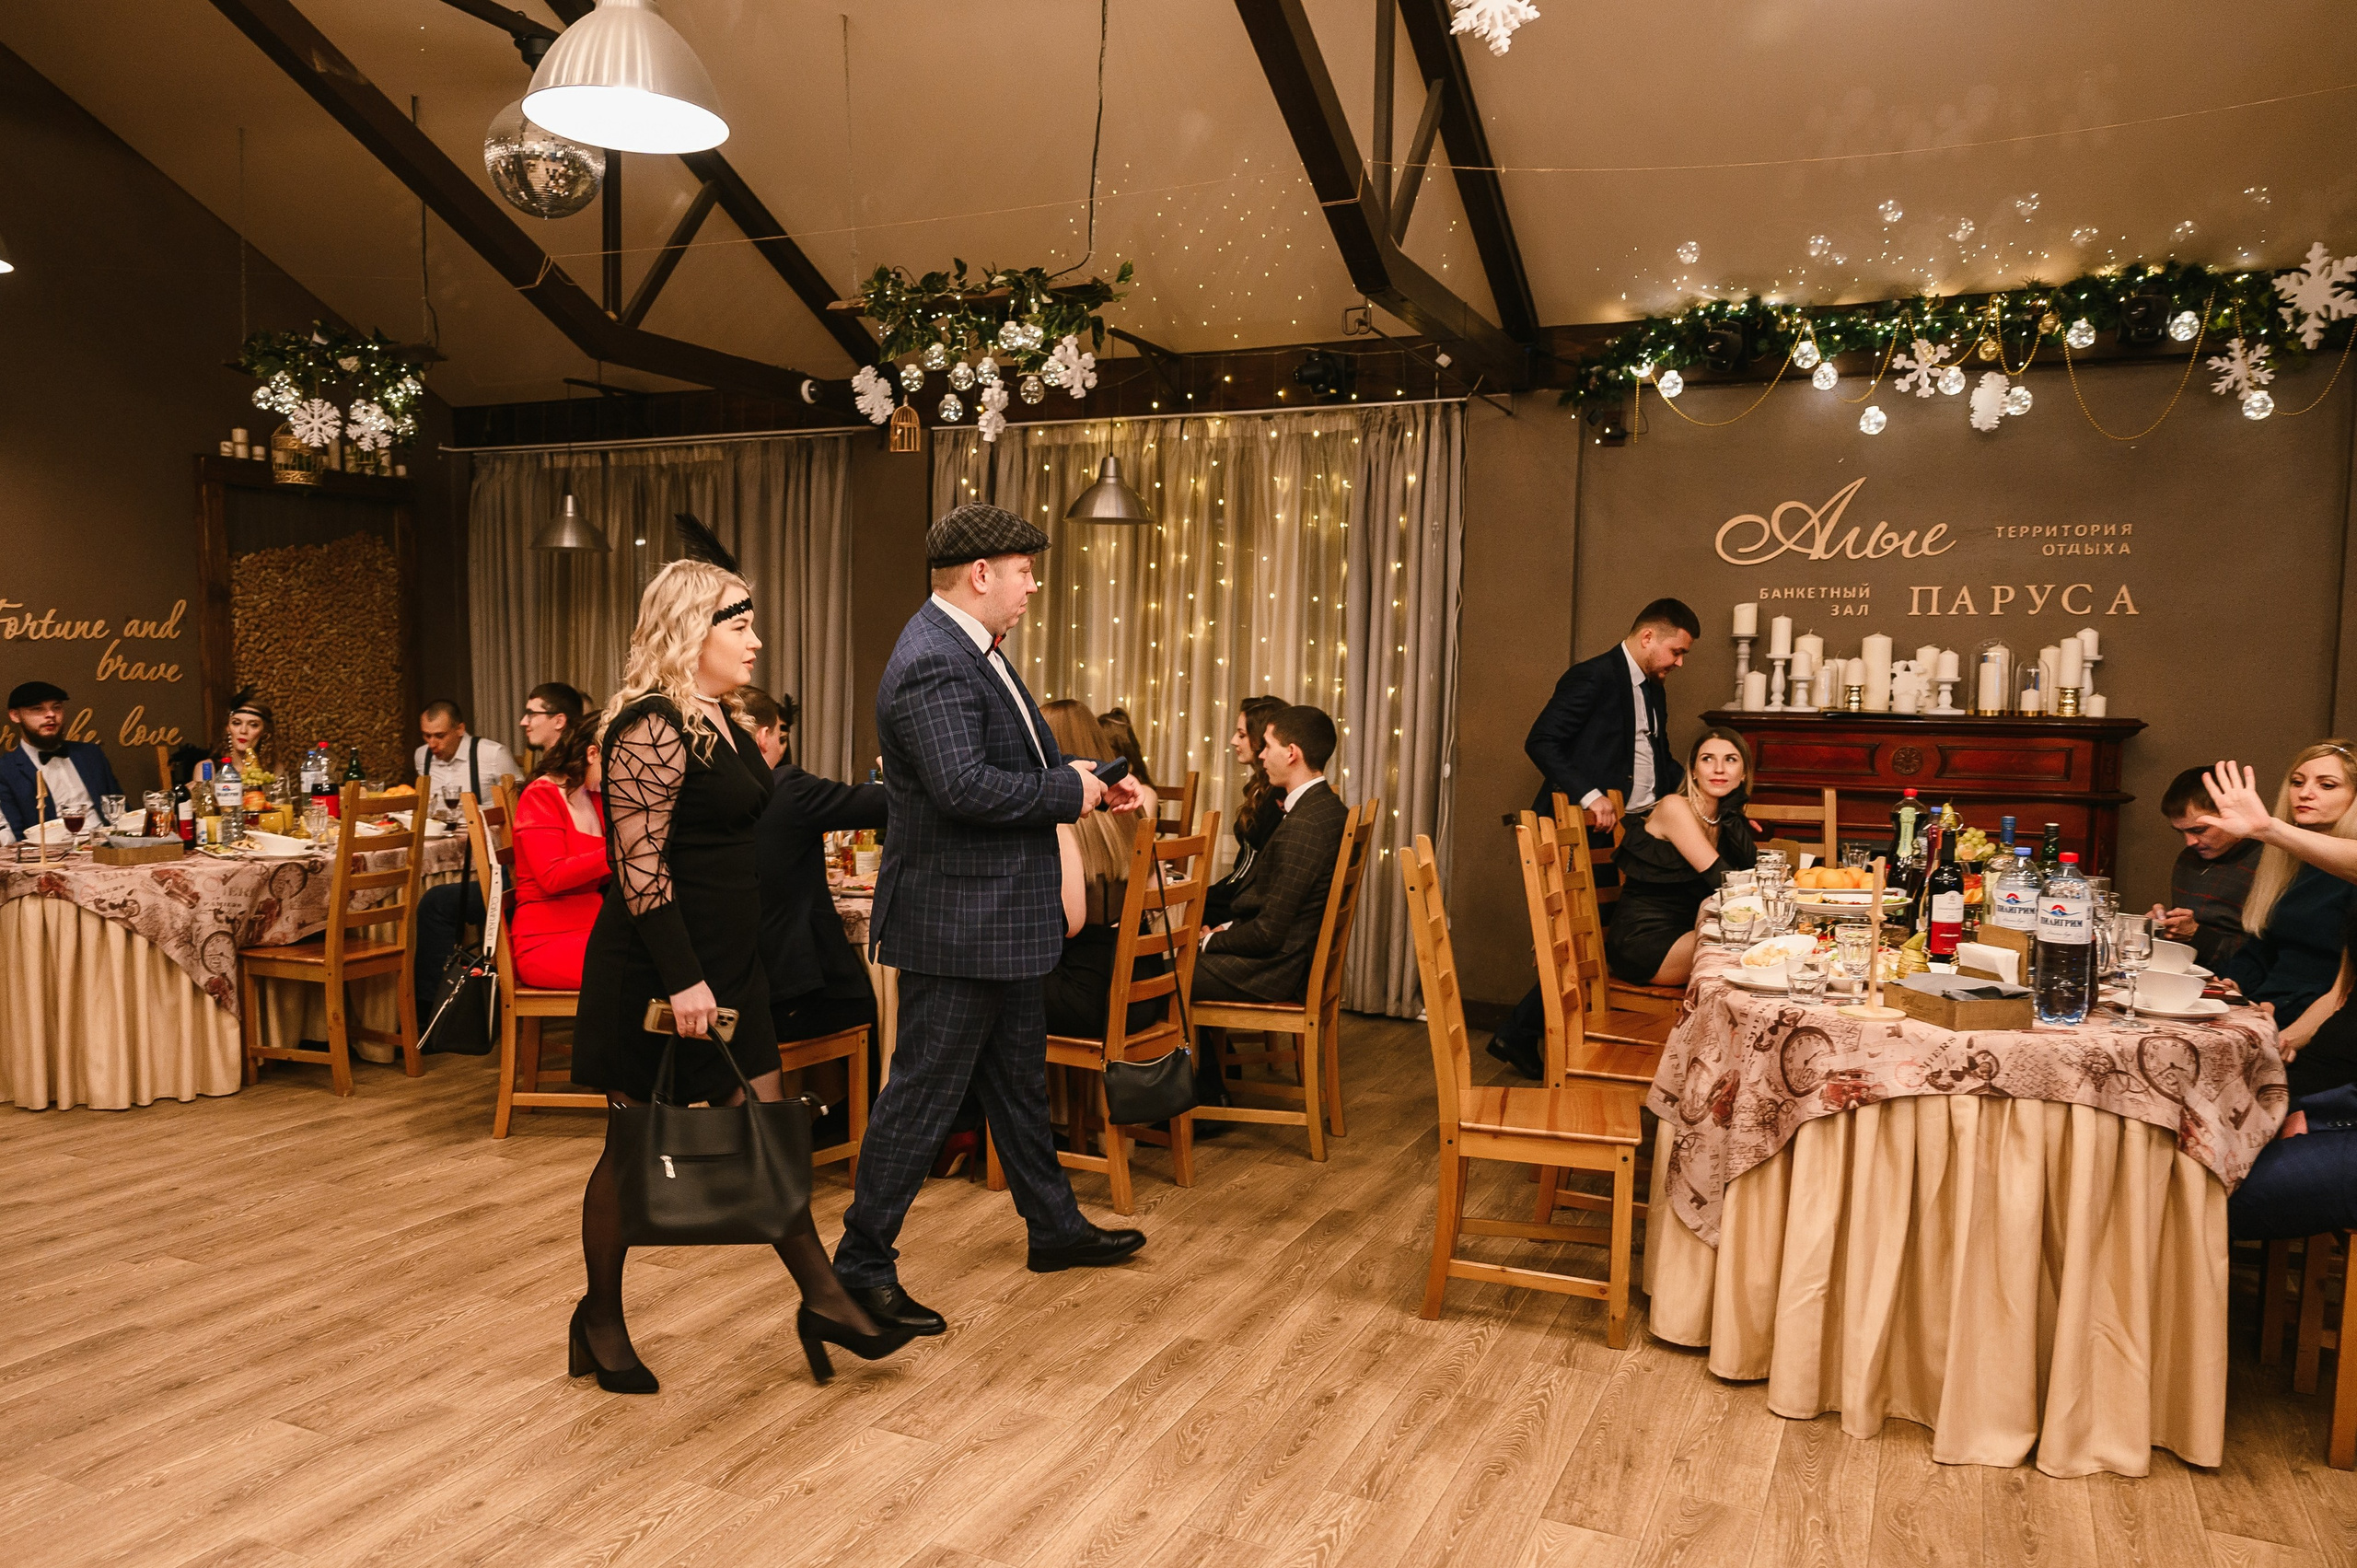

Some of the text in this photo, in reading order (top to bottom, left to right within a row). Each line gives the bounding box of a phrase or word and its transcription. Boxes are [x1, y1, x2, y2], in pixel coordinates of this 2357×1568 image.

[1715, 476, 1956, 565] Алые
[1995, 523, 2133, 539] ТЕРРИТОРИЯ
[2041, 542, 2131, 556] ОТДЫХА
[1759, 583, 1871, 599] БАНКЕТНЫЙ
[1907, 583, 2140, 615] ПАРУСА
[123, 598, 187, 639] and
[1830, 604, 1869, 616] ЗАЛ
[96, 639, 183, 682] brave
[119, 704, 183, 747] love
